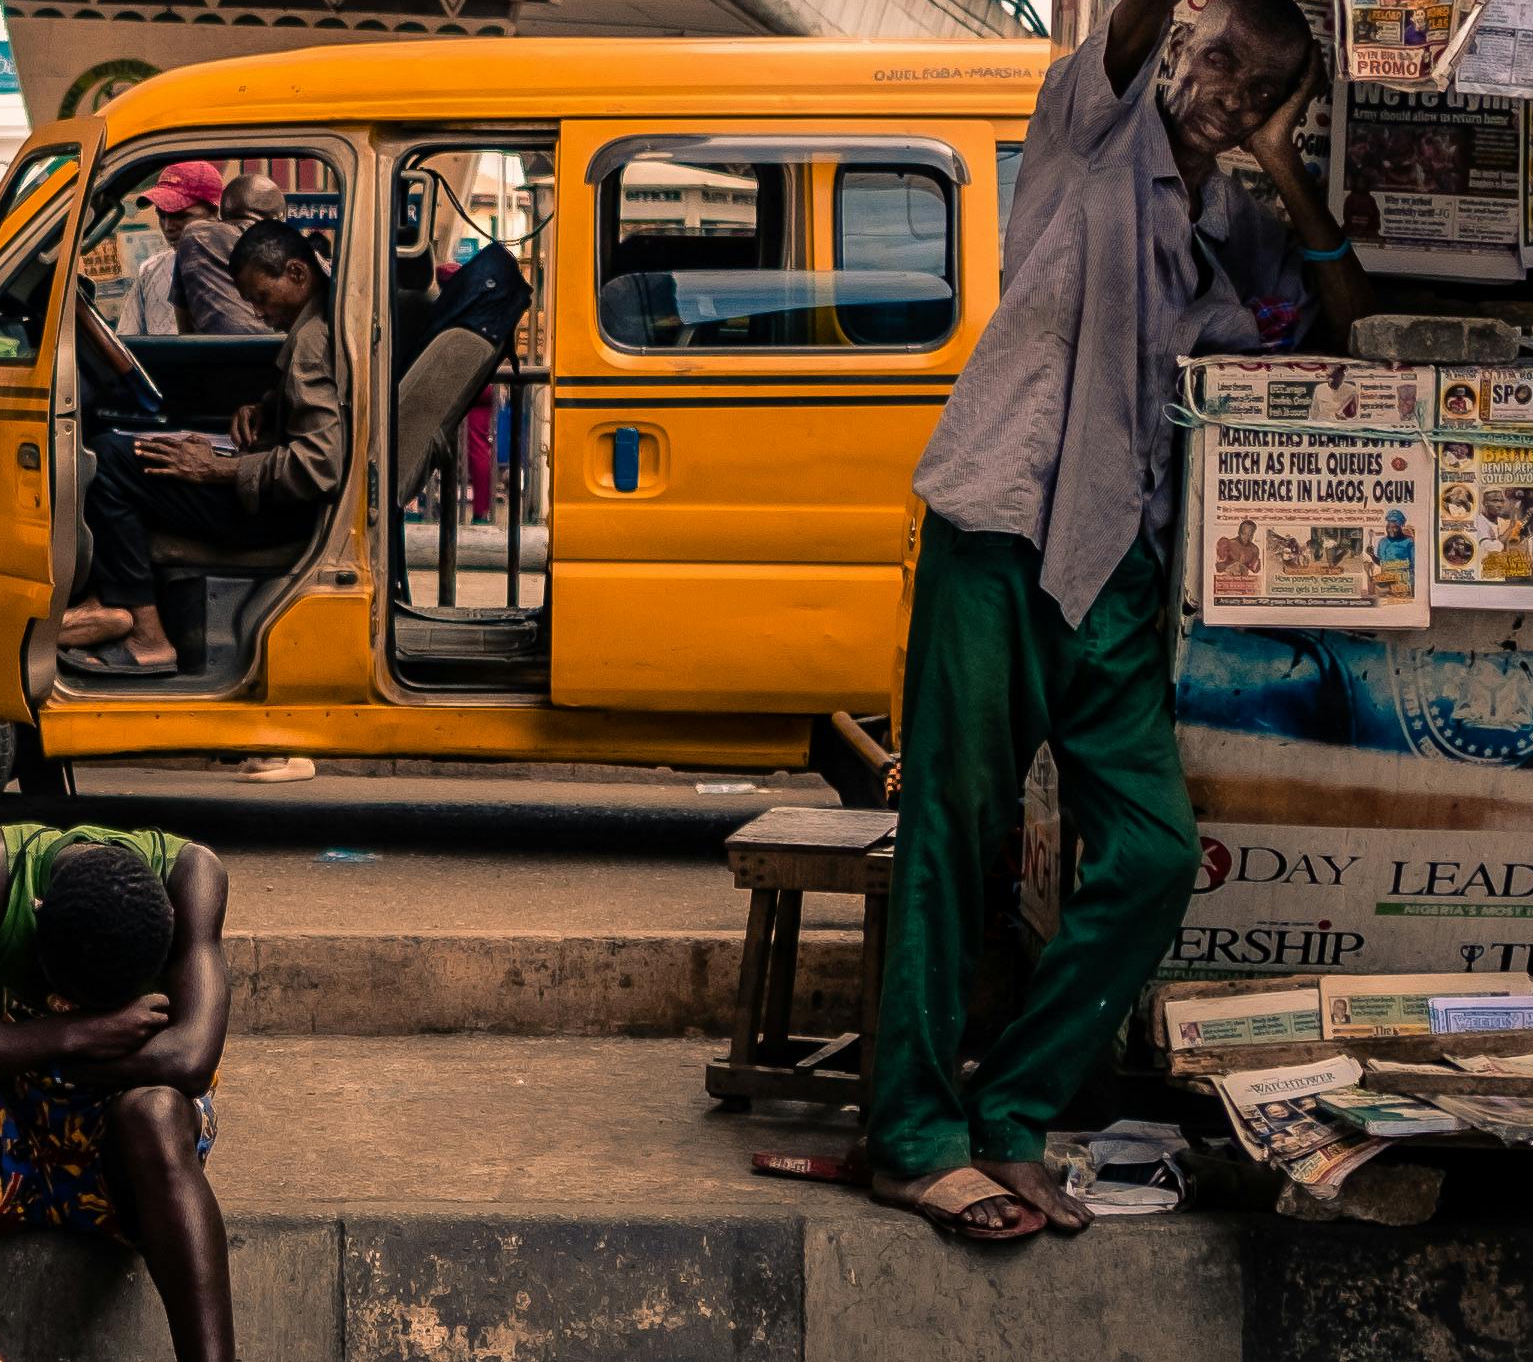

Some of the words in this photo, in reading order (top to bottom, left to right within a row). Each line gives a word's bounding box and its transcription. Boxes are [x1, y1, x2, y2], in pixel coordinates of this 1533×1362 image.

[1357, 60, 1418, 76] PROMO
[1218, 451, 1260, 475] HITCH
[1264, 452, 1285, 475] AS
[1289, 453, 1322, 475] FUEL
[1326, 453, 1383, 477] QUEUES
[1217, 479, 1294, 502] RESURFACE
[1297, 480, 1313, 502] IN
[1316, 480, 1369, 509] LAGOS,
[1372, 480, 1415, 504] OGUN
[1235, 846, 1363, 889] DAY
